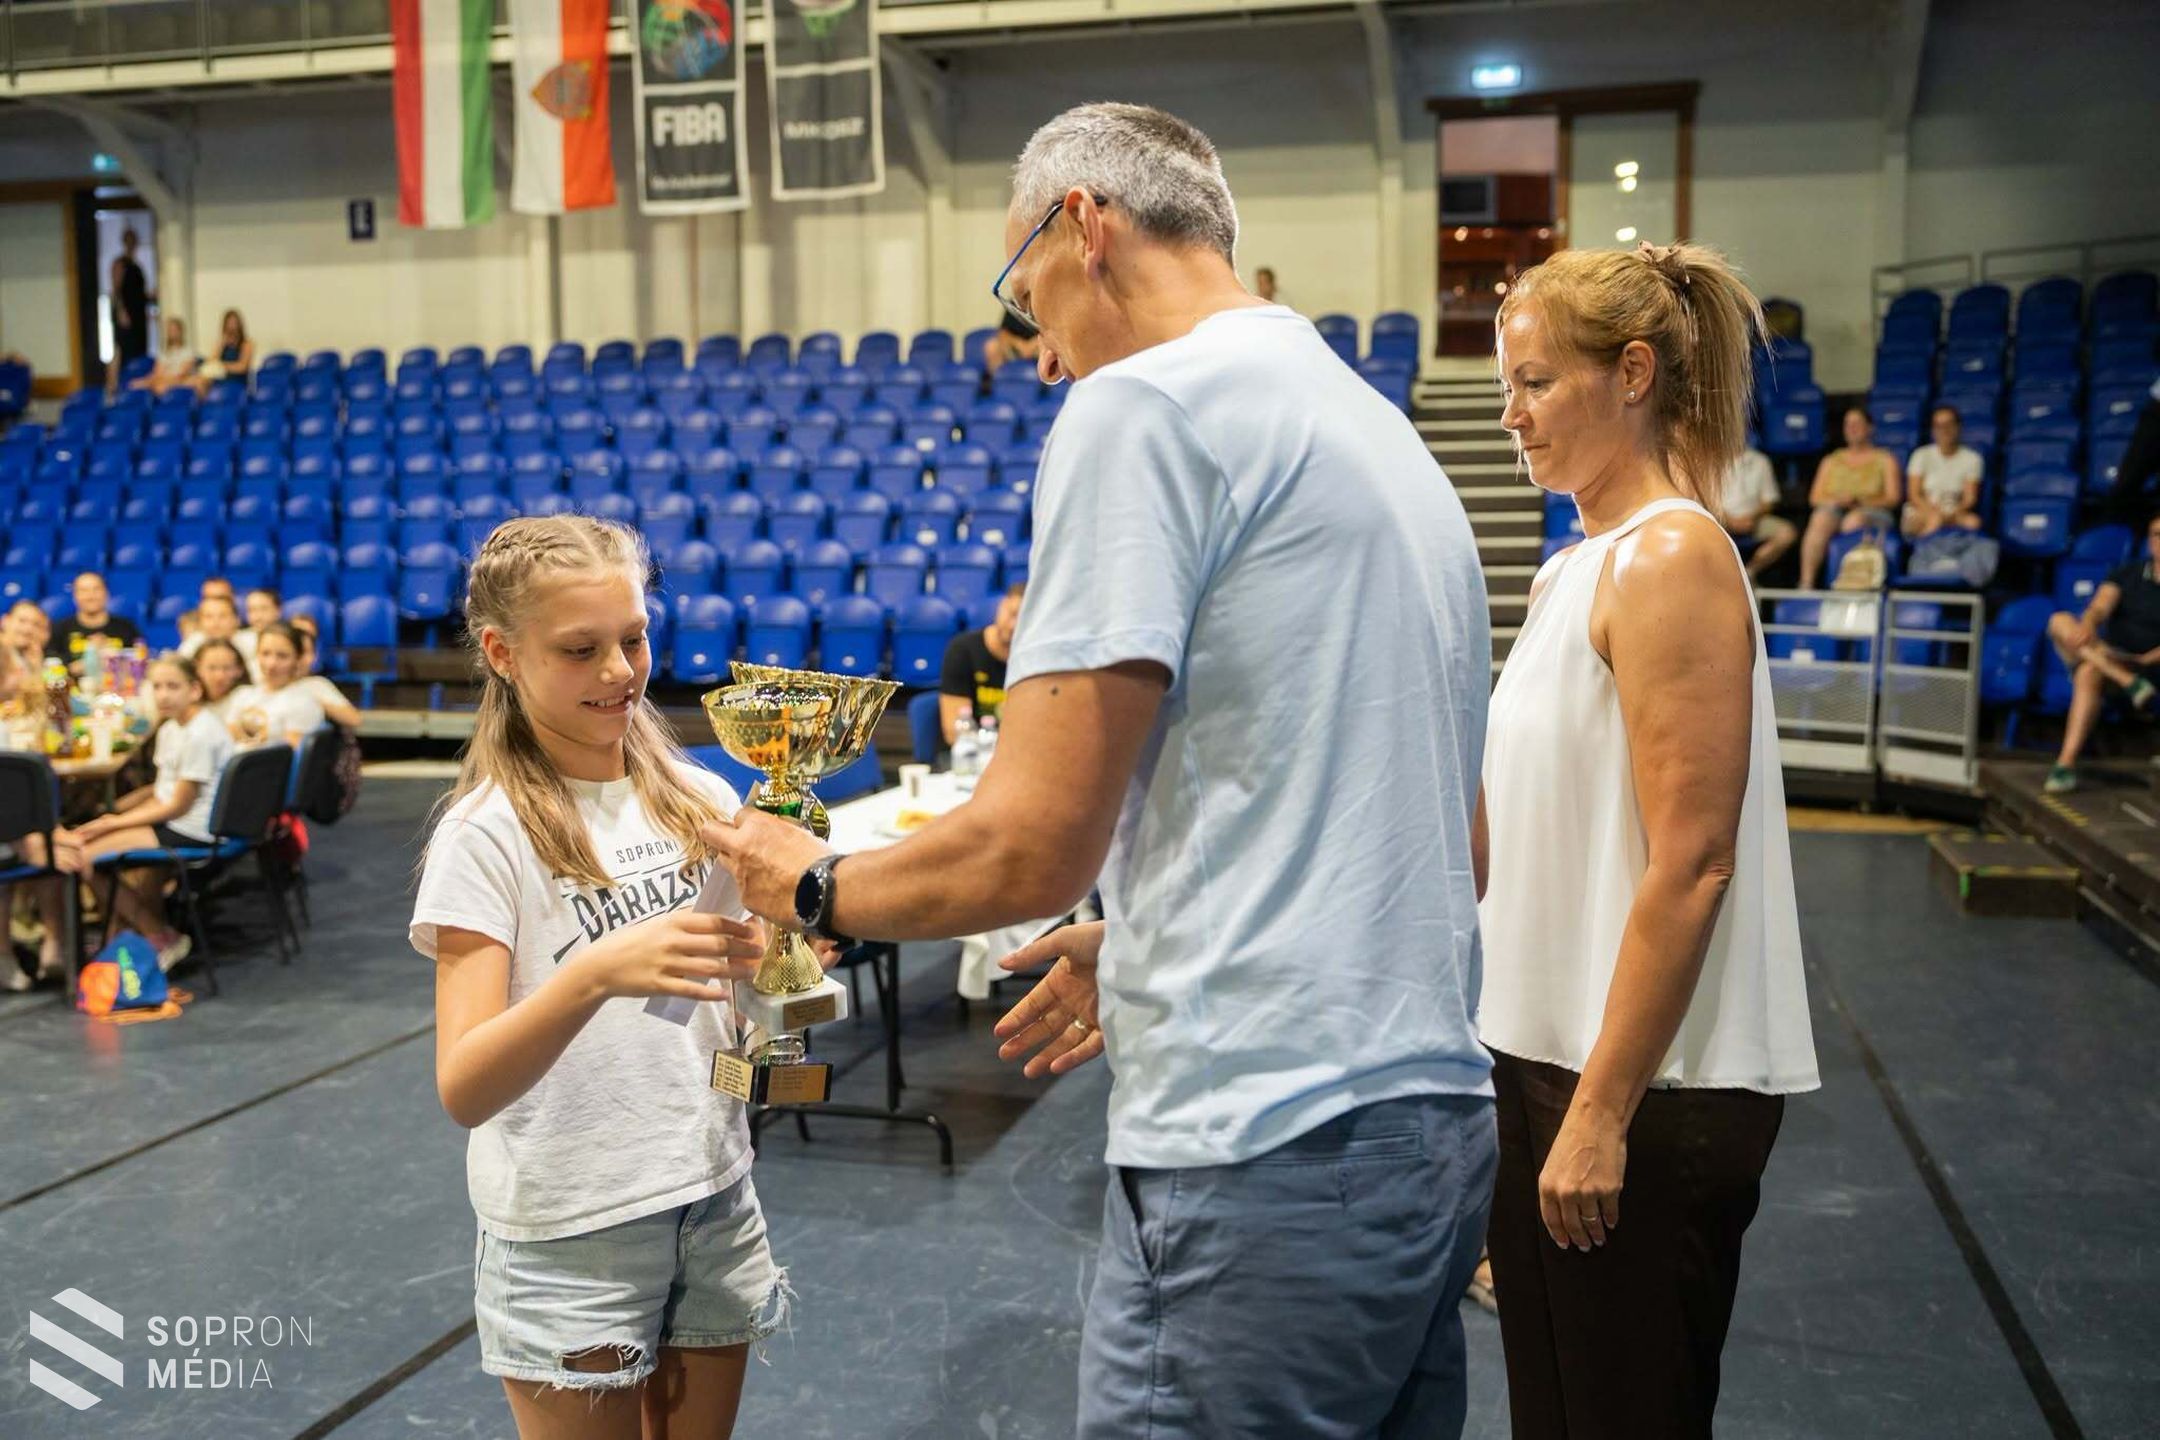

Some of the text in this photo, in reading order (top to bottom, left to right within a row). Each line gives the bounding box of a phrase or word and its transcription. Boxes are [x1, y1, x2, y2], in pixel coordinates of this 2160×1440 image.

[651, 102, 727, 147] FIBA
[615, 839, 680, 864] SOPRONI
[571, 859, 710, 944] DARAZS
